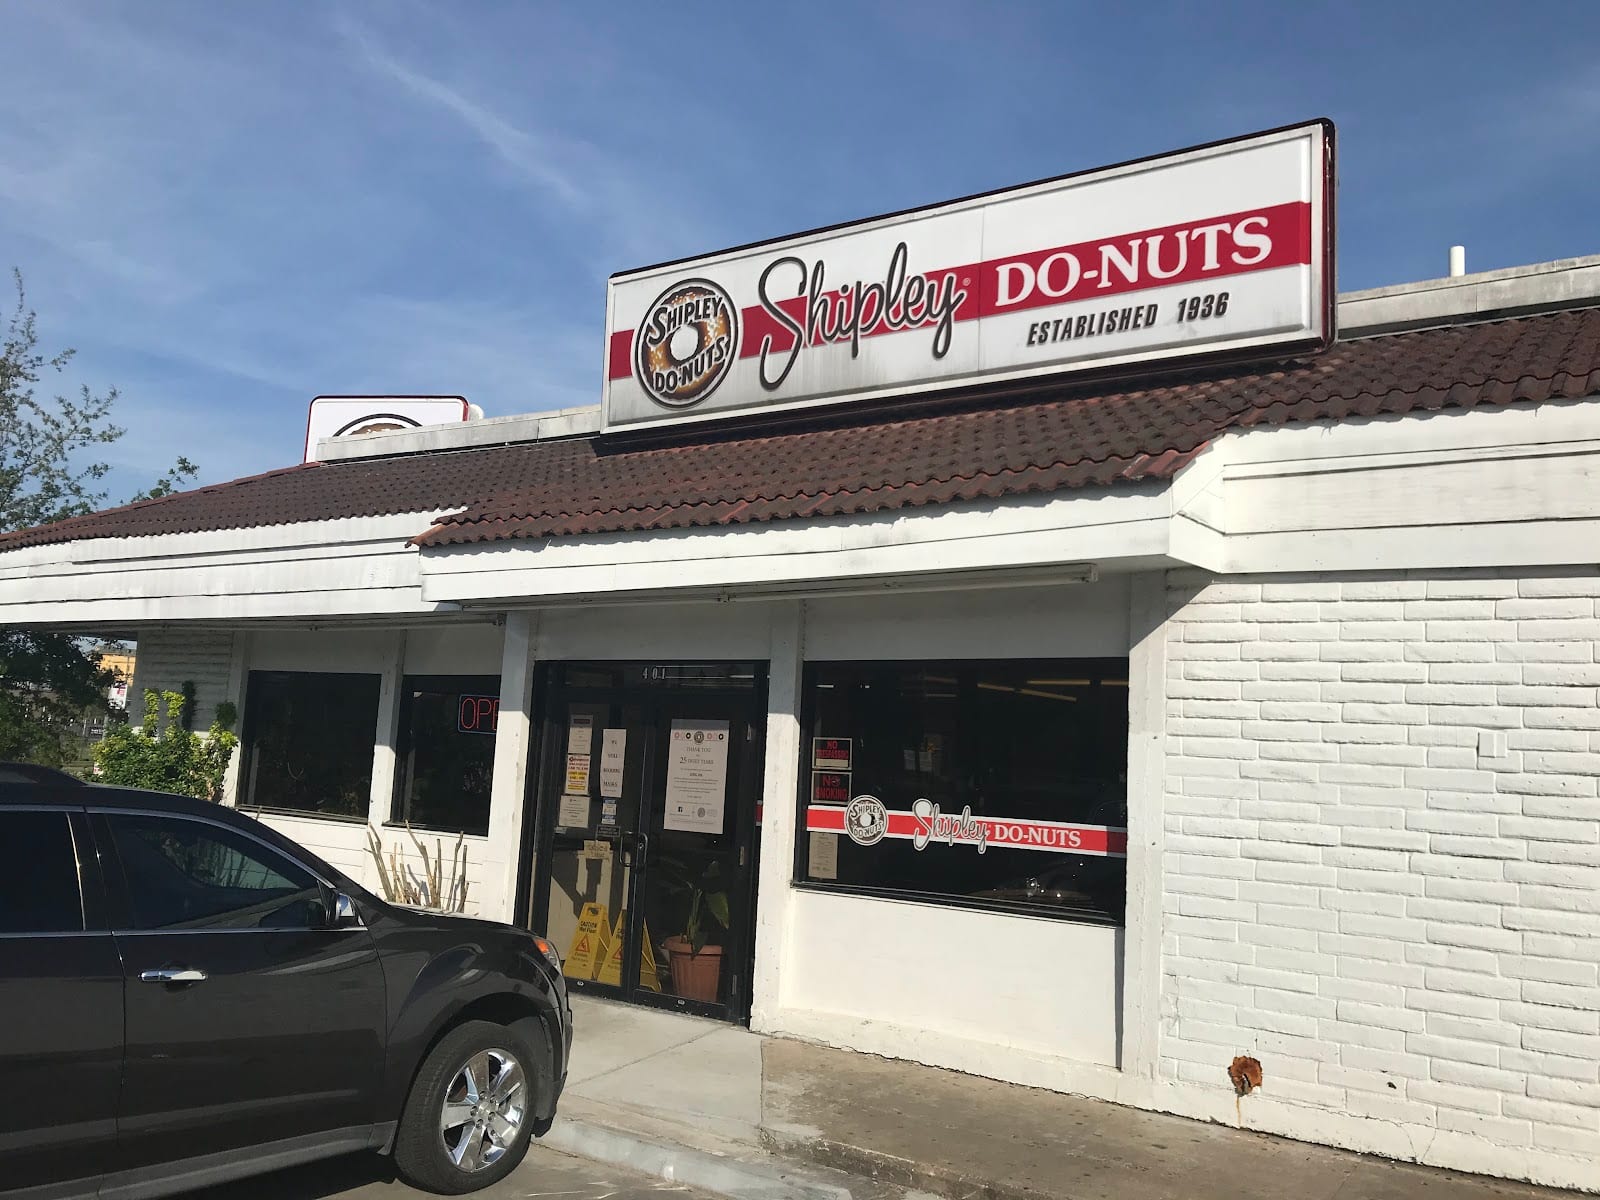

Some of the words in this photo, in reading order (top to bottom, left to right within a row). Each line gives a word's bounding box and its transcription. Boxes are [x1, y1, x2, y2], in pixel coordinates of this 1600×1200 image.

[647, 296, 722, 345] SHIPLEY
[758, 241, 966, 391] Shipley
[994, 216, 1273, 307] DO-NUTS
[1027, 303, 1159, 346] ESTABLISHED
[1177, 292, 1230, 324] 1936
[642, 667, 665, 680] 401
[850, 803, 881, 818] SHIPLEY
[911, 799, 990, 854] Shipley
[994, 823, 1082, 847] DO-NUTS
